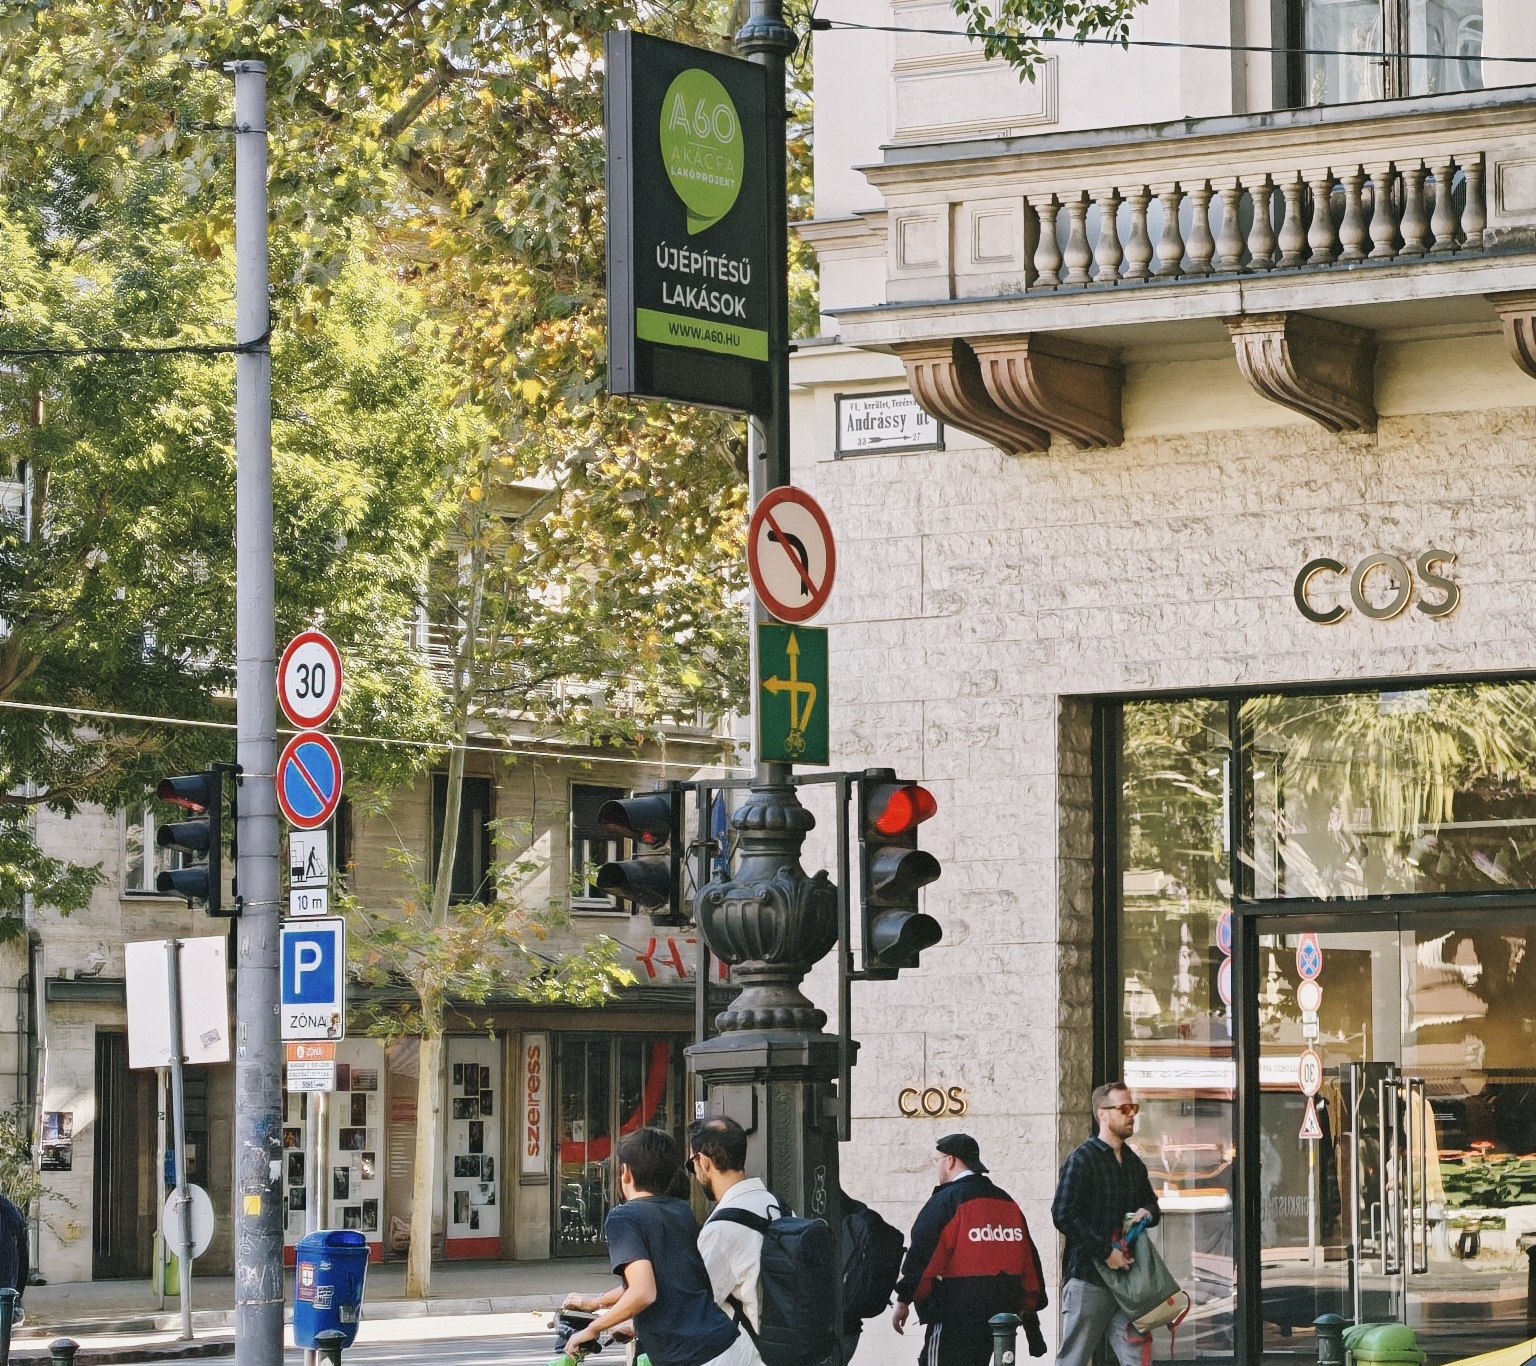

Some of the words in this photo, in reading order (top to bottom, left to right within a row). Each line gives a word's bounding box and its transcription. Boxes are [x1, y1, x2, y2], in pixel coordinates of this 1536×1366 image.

[668, 92, 736, 144] A60
[671, 145, 735, 176] AKÁCFA
[656, 240, 751, 285] ÚJÉPÍTÉSŰ
[662, 283, 747, 319] LAKÁSOK
[668, 321, 741, 347] WWW.A60.HU
[846, 411, 907, 433] Andrássy
[857, 437, 867, 446] 33
[912, 432, 921, 441] 27
[1293, 548, 1461, 625] COS
[295, 662, 326, 699] 30
[297, 895, 308, 911] 10
[312, 897, 323, 909] m
[294, 940, 323, 994] P
[289, 1012, 327, 1029] ZÓNA
[527, 1044, 541, 1157] szeress
[898, 1086, 968, 1116] COS
[968, 1223, 1023, 1242] adidas
